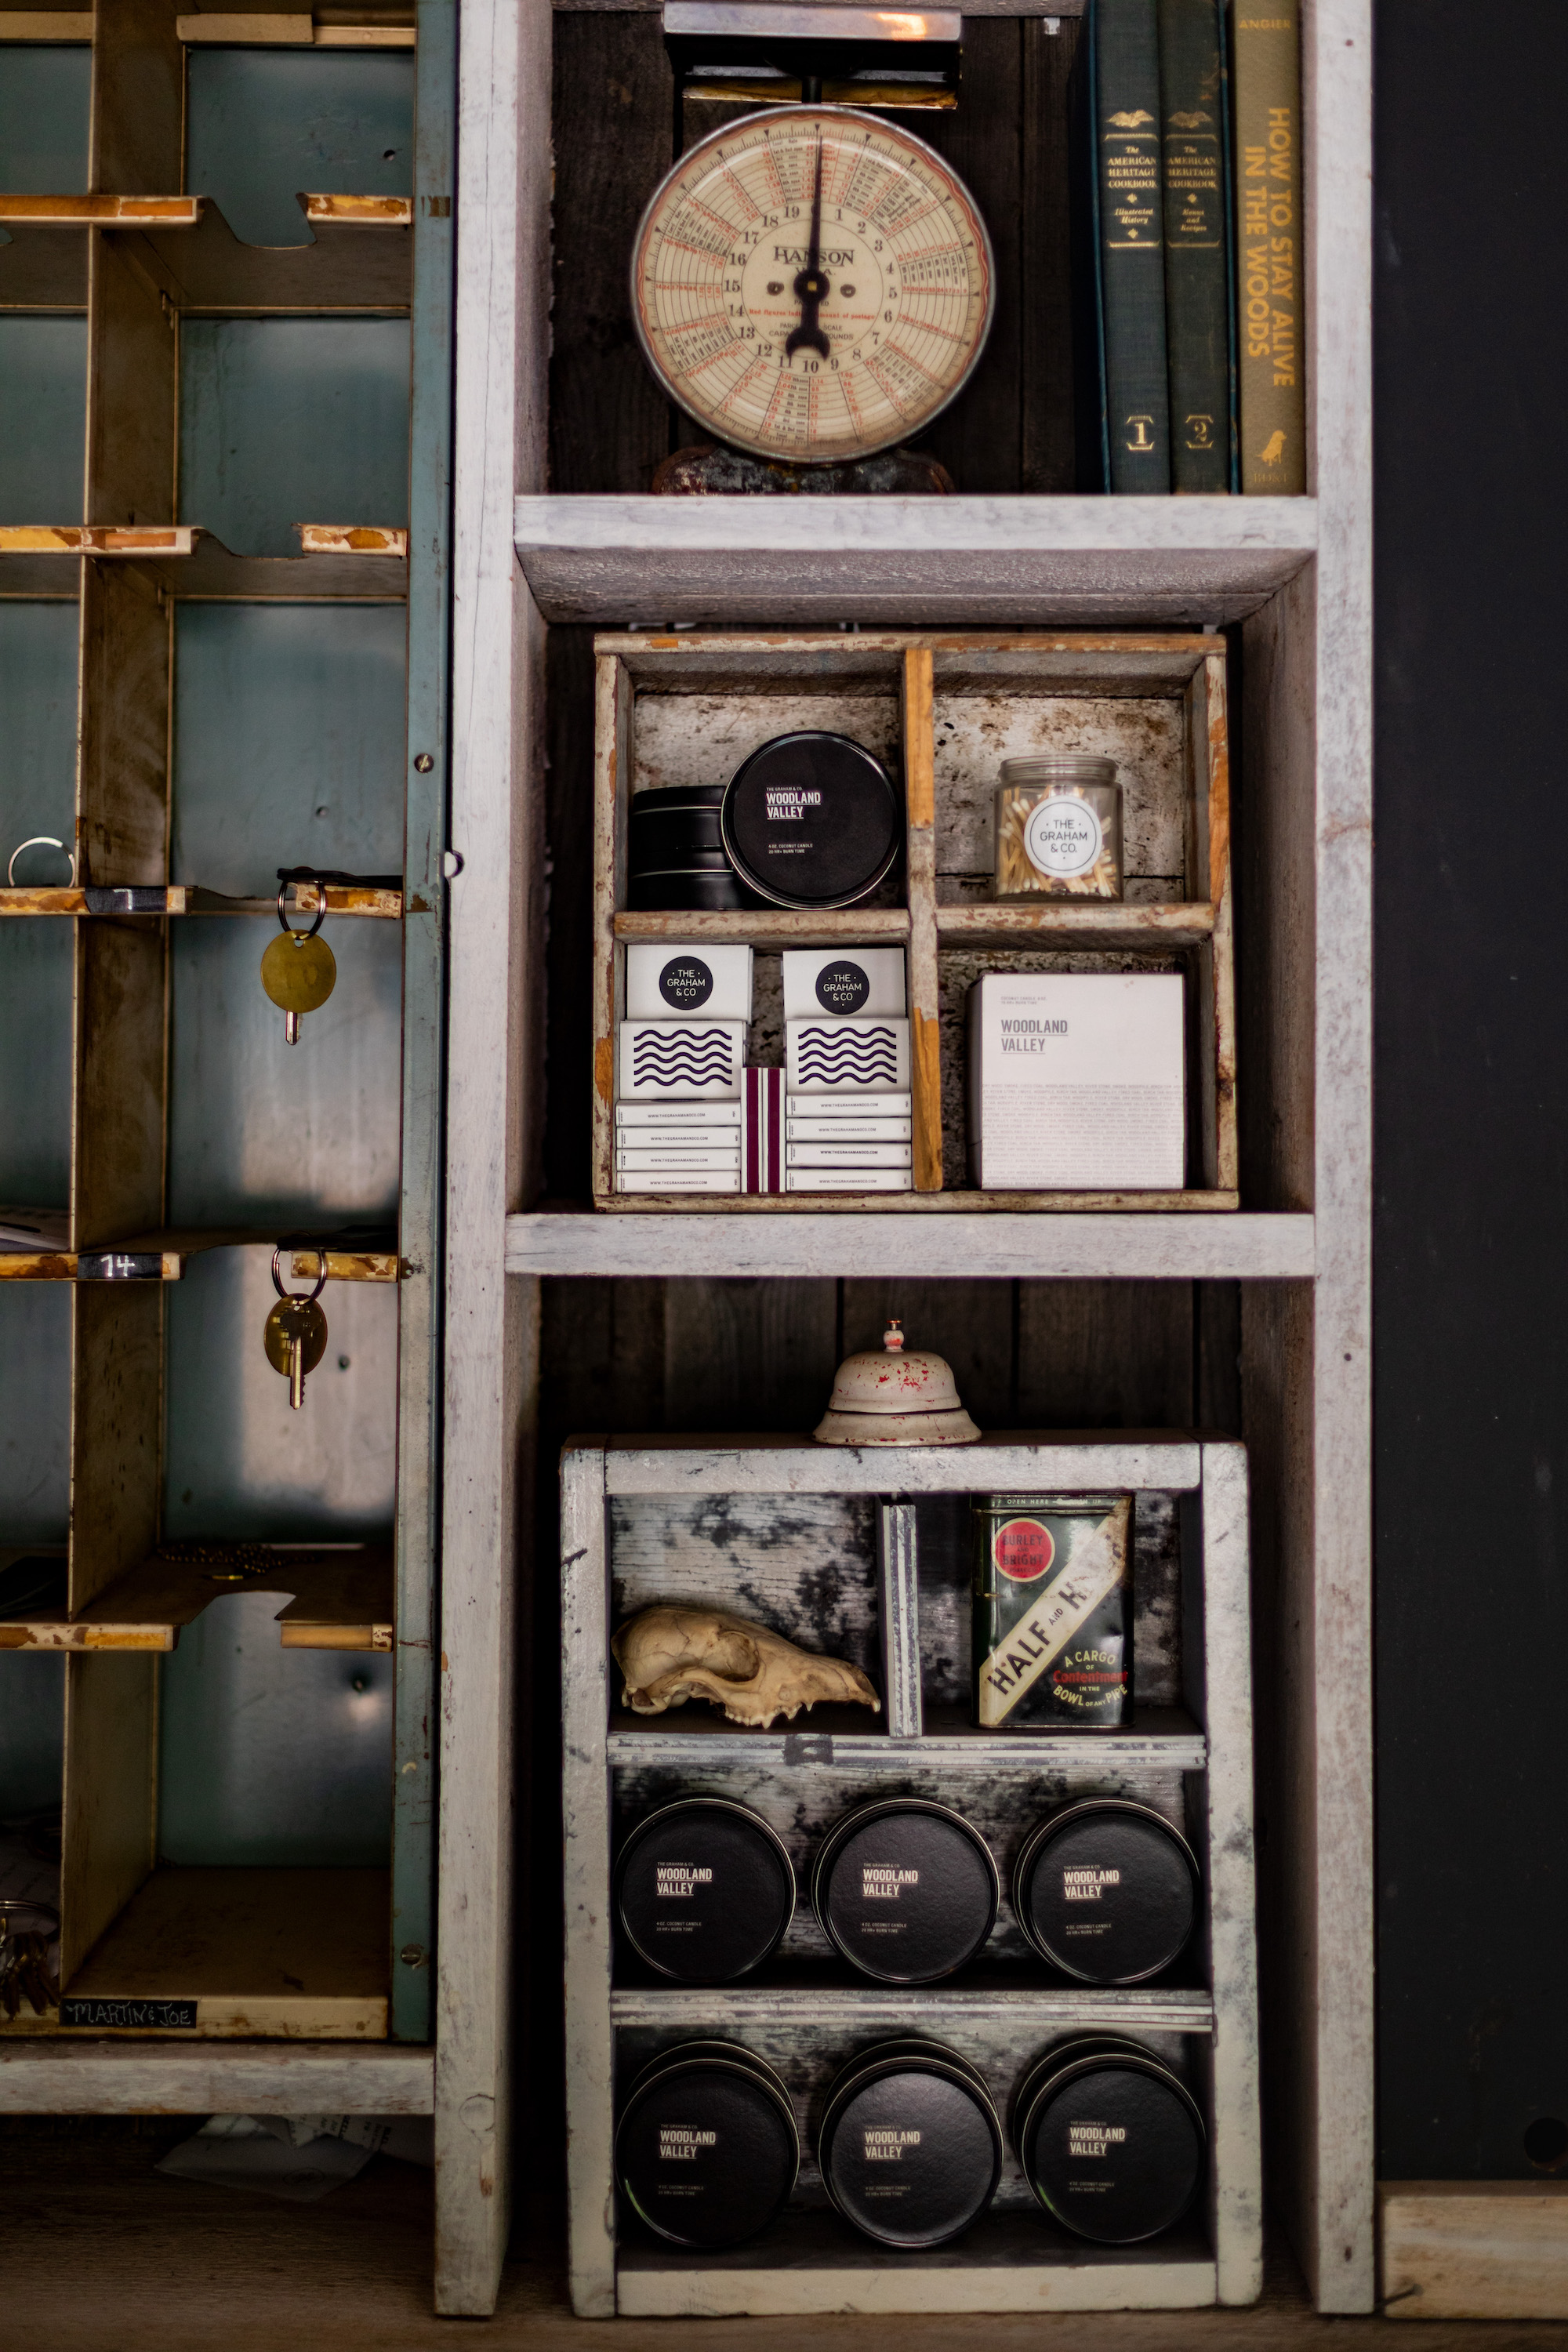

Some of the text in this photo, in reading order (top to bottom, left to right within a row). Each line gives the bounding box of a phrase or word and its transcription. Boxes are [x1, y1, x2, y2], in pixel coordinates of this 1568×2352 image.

[1240, 19, 1290, 29] ANGIER
[1108, 156, 1156, 165] AMERICAN
[1109, 168, 1156, 176] HERITAGE
[1168, 168, 1216, 176] HERITAGE
[1108, 180, 1157, 188] COOKBOOK
[1168, 180, 1217, 188] COOKBOOK
[784, 206, 800, 218] 19
[835, 209, 842, 220] 1
[762, 215, 779, 227] 18
[1121, 216, 1149, 224] History
[858, 222, 866, 234] 2
[745, 231, 759, 244] 17
[874, 239, 883, 252] 3
[1269, 108, 1294, 386] HOW TO STAY ALIVE
[1245, 146, 1269, 358] IN THE WOODS
[729, 252, 746, 266] 16
[886, 262, 893, 274] 4
[724, 279, 740, 292] 15
[888, 287, 897, 299] 5
[729, 303, 744, 318] 14
[884, 310, 892, 322] 6
[739, 327, 754, 339] 13
[873, 332, 880, 345] 7
[757, 344, 772, 357] 12
[852, 348, 861, 361] 8
[779, 355, 792, 368] 11
[803, 360, 818, 373] 10
[831, 358, 839, 371] 9
[1135, 423, 1146, 444] 1
[1194, 422, 1207, 441] 2
[766, 792, 821, 804] WOODLAND
[767, 806, 803, 818] VALLEY
[1054, 819, 1075, 829] THE
[1040, 831, 1087, 841] GRAHAM
[1051, 843, 1076, 853] & CO.
[677, 969, 695, 978] THE
[833, 974, 851, 982] THE
[676, 988, 696, 996] & CO
[823, 983, 862, 992] GRAHAM
[833, 993, 853, 1001] & CO
[1001, 1019, 1068, 1033] WOODLAND
[1001, 1038, 1045, 1051] VALLEY
[100, 1254, 136, 1277] 14
[1002, 1534, 1043, 1545] BURLEY
[1003, 1554, 1044, 1566] BRIGHT
[986, 1608, 1063, 1695] HALF AND
[1065, 1650, 1116, 1668] A CARGO
[1053, 1670, 1127, 1683] Contentment
[1053, 1685, 1083, 1706] BOWL
[1105, 1684, 1127, 1704] PIPE
[657, 1867, 712, 1880] WOODLAND
[863, 1869, 918, 1882] WOODLAND
[1064, 1870, 1120, 1883] WOODLAND
[657, 1882, 694, 1894] VALLEY
[863, 1883, 899, 1896] VALLEY
[1065, 1886, 1102, 1897] VALLEY
[66, 2001, 147, 2025] MARTIN
[157, 2002, 191, 2026] JOE
[660, 2129, 716, 2143] WOODLAND
[865, 2131, 920, 2143] WOODLAND
[1070, 2127, 1125, 2140] WOODLAND
[660, 2145, 697, 2158] VALLEY
[865, 2146, 902, 2158] VALLEY
[1070, 2142, 1107, 2154] VALLEY
